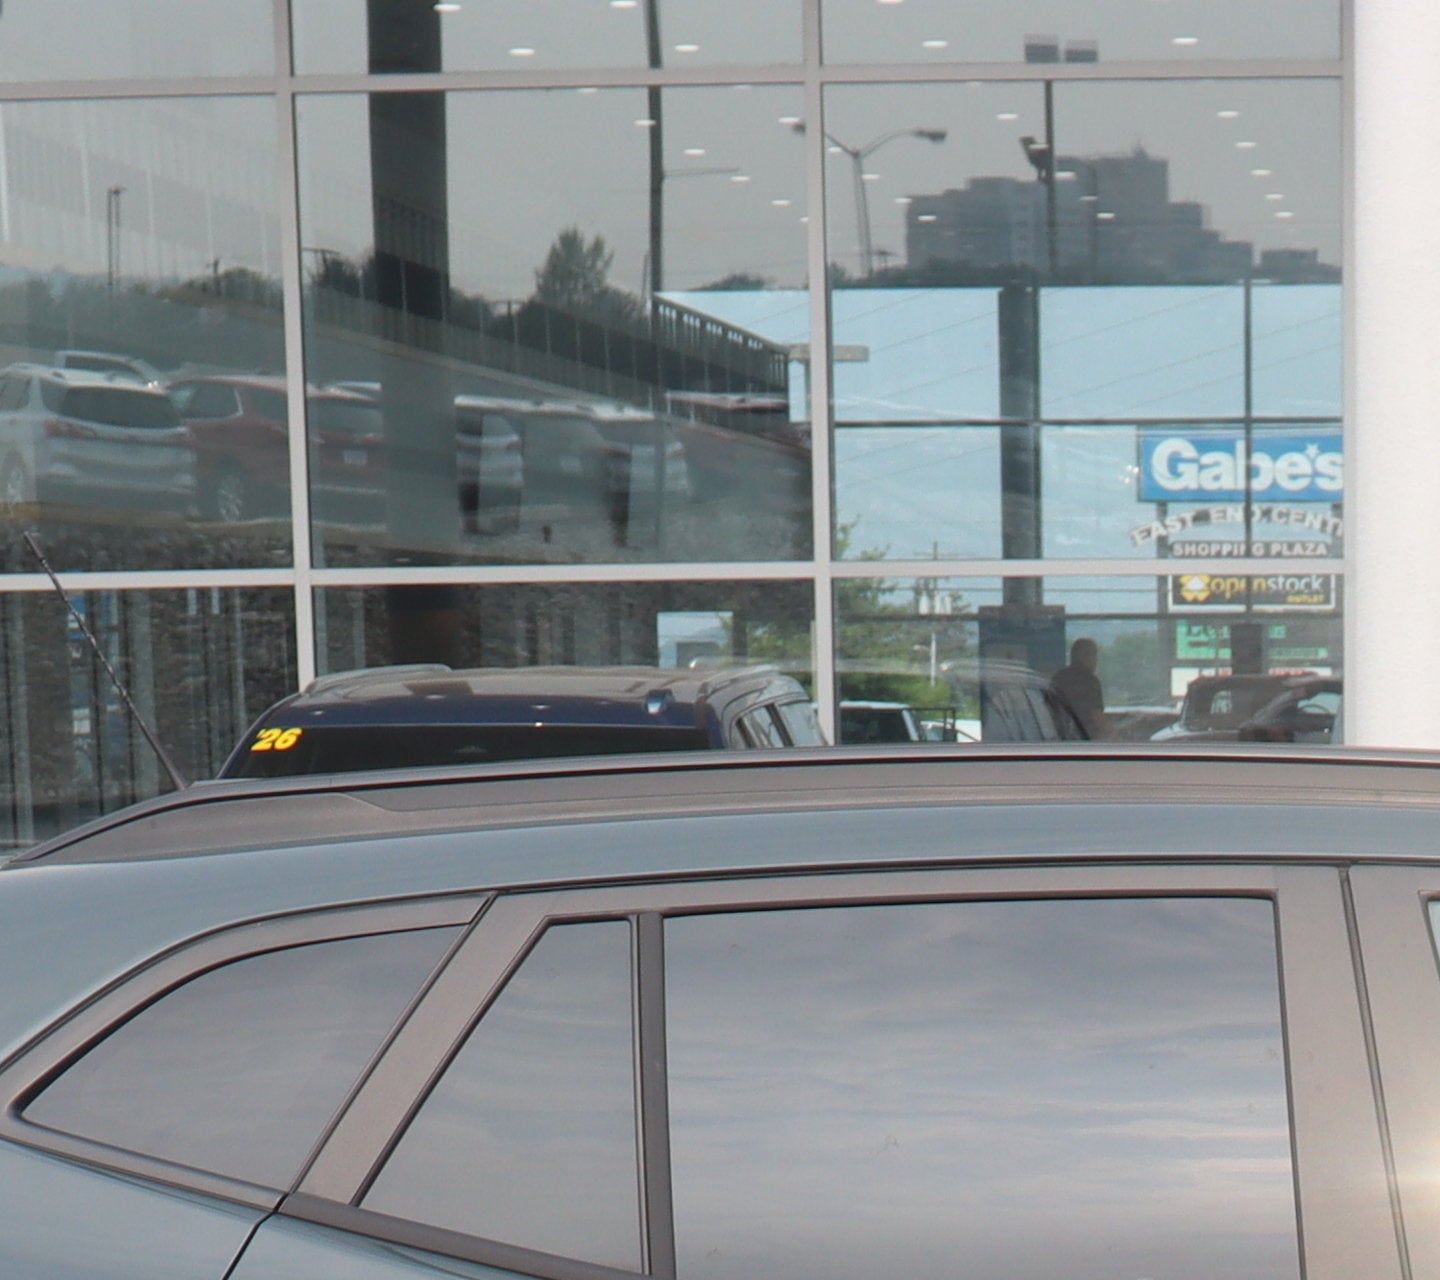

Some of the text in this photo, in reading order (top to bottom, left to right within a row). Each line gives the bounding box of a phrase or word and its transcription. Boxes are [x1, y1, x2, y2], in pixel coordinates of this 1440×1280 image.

[1151, 437, 1343, 491] Gabe's
[1130, 511, 1197, 545] EAST
[1172, 542, 1329, 557] SHOPPIG PLAZA
[1211, 574, 1324, 598] opnstock
[250, 728, 302, 751] '26
